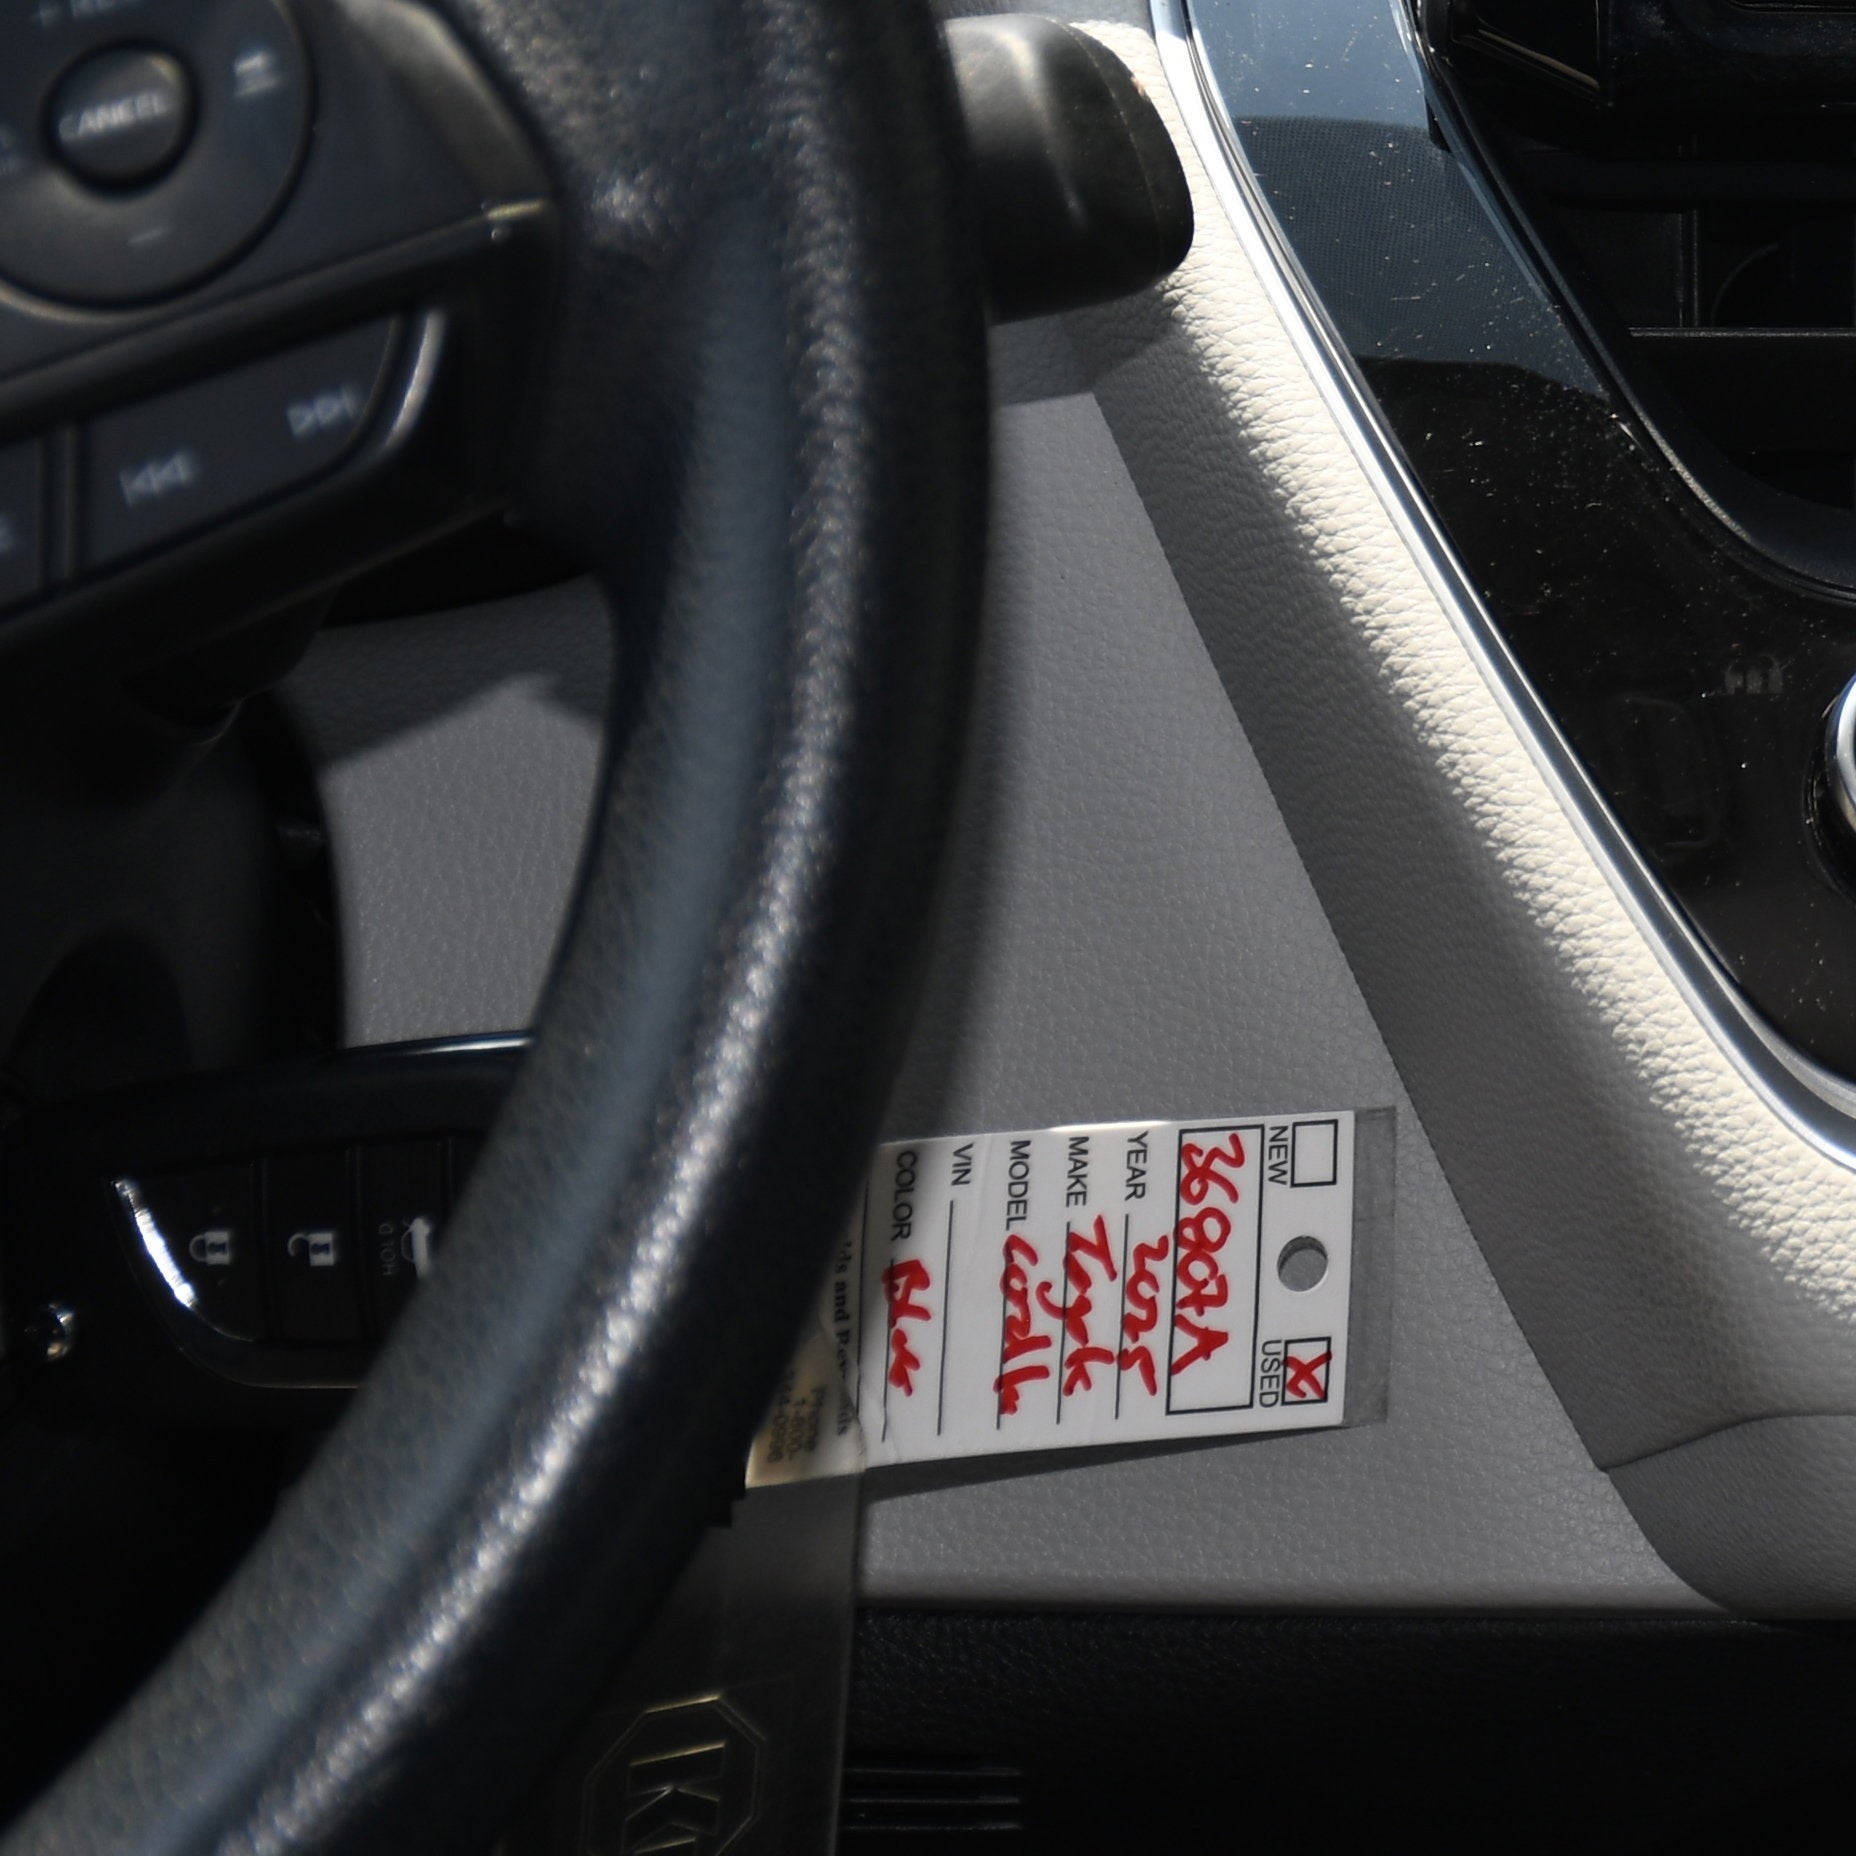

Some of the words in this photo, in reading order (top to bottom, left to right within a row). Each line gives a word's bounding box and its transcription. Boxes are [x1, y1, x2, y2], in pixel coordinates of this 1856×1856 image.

[58, 90, 170, 143] CANCEL
[951, 1143, 974, 1187] VIN
[1006, 1139, 1031, 1231] MODEL
[1065, 1135, 1089, 1207] MAKE
[1123, 1130, 1150, 1202] YEAR
[1268, 1125, 1289, 1187] NEW
[891, 1149, 918, 1242] COLOR
[379, 1222, 396, 1276] HOLD
[1120, 1234, 1170, 1397] 2025
[1259, 1338, 1283, 1410] USED
